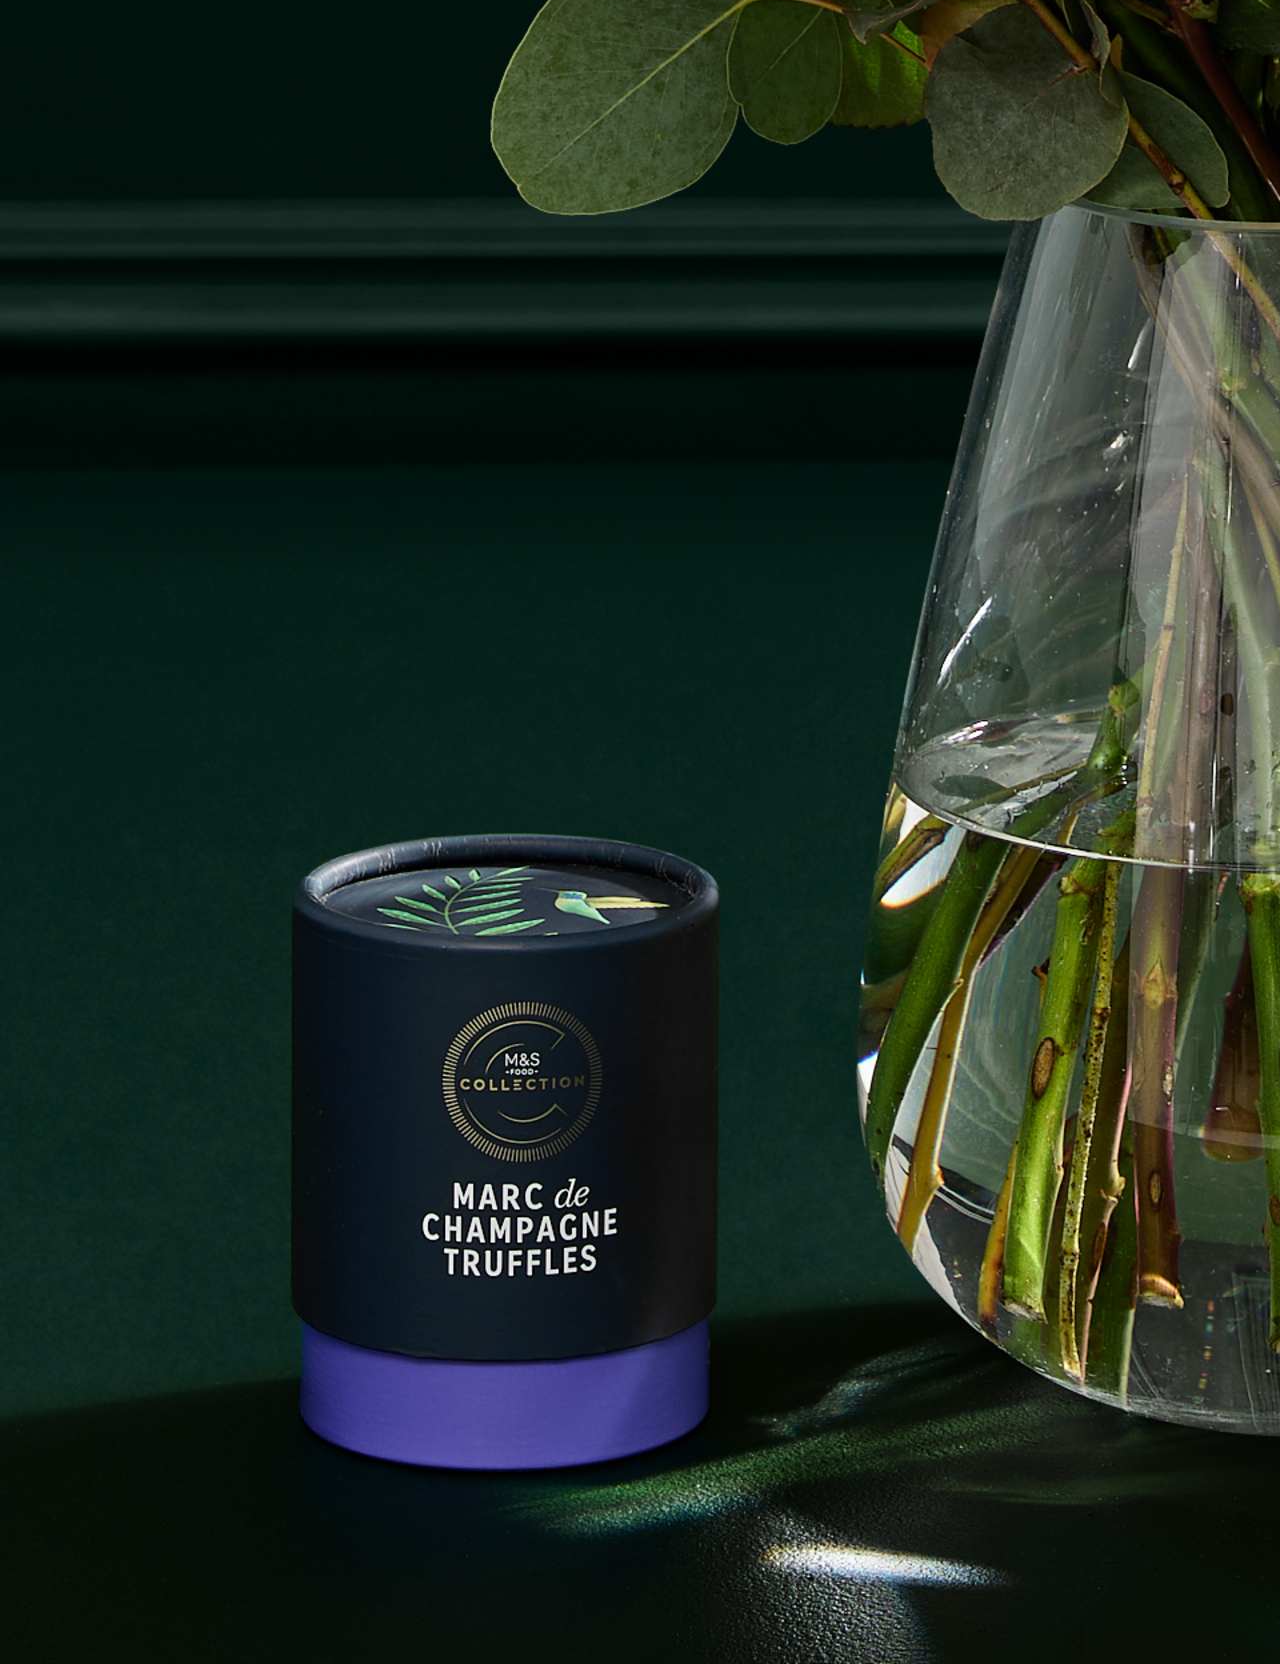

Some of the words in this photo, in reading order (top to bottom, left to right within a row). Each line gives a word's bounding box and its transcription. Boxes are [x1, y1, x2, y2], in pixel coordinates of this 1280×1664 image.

[503, 1052, 542, 1067] M&S
[459, 1075, 585, 1092] COLLECTION
[452, 1182, 544, 1211] MARC
[553, 1177, 591, 1209] de
[421, 1207, 619, 1244] CHAMPAGNE
[443, 1245, 598, 1278] TRUFFLES
